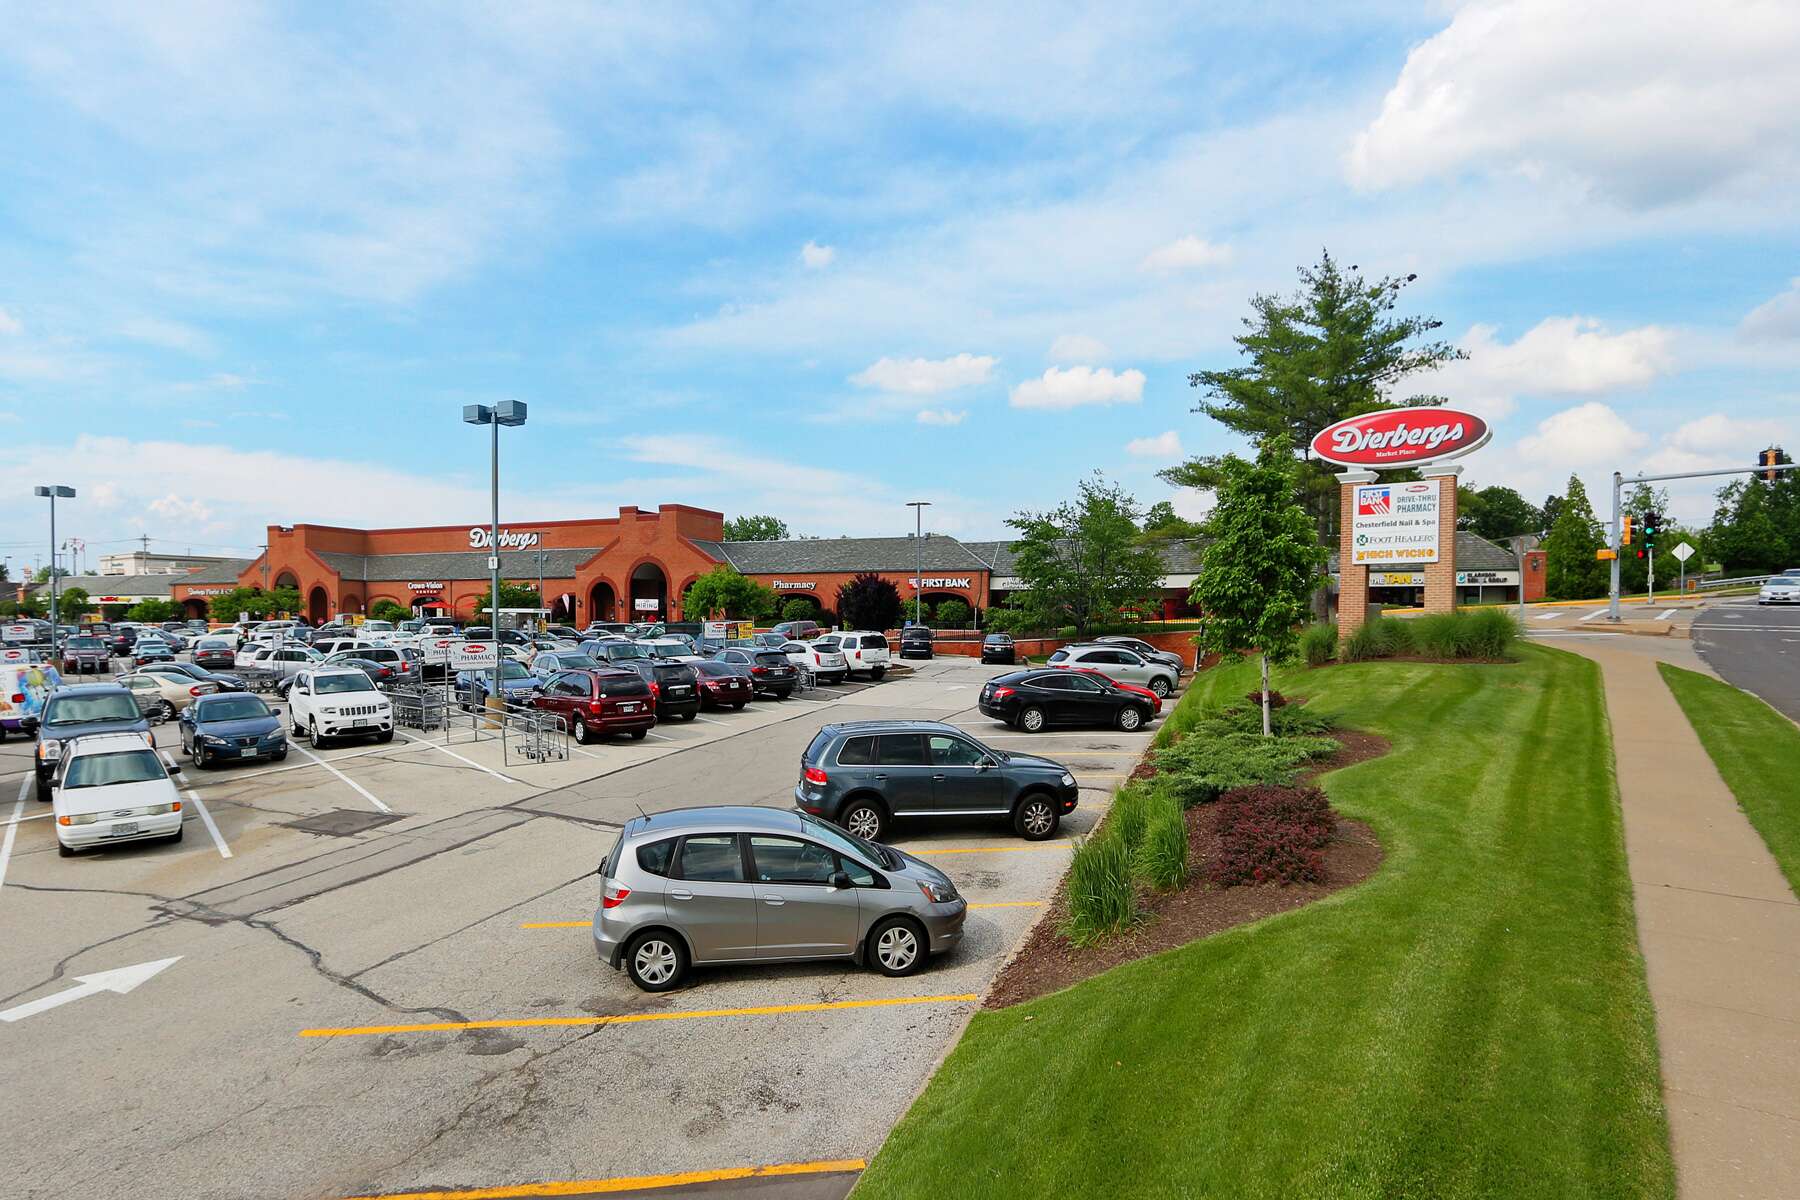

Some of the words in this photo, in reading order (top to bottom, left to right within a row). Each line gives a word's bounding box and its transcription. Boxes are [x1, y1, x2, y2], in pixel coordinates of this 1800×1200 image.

[1331, 423, 1463, 453] Dierbergs
[1360, 496, 1385, 506] BANK
[1397, 494, 1437, 504] DRIVE-THRU
[1397, 503, 1437, 513] PHARMACY
[1356, 520, 1397, 529] Chesterfield
[1422, 518, 1435, 526] Spa
[1369, 536, 1392, 544] FOOT
[1394, 535, 1434, 543] HEALERS
[1395, 548, 1425, 558] WICH
[921, 578, 945, 588] FIRST
[945, 577, 971, 589] BANK
[1384, 573, 1411, 584] TAN
[773, 580, 816, 590] Pharmacy
